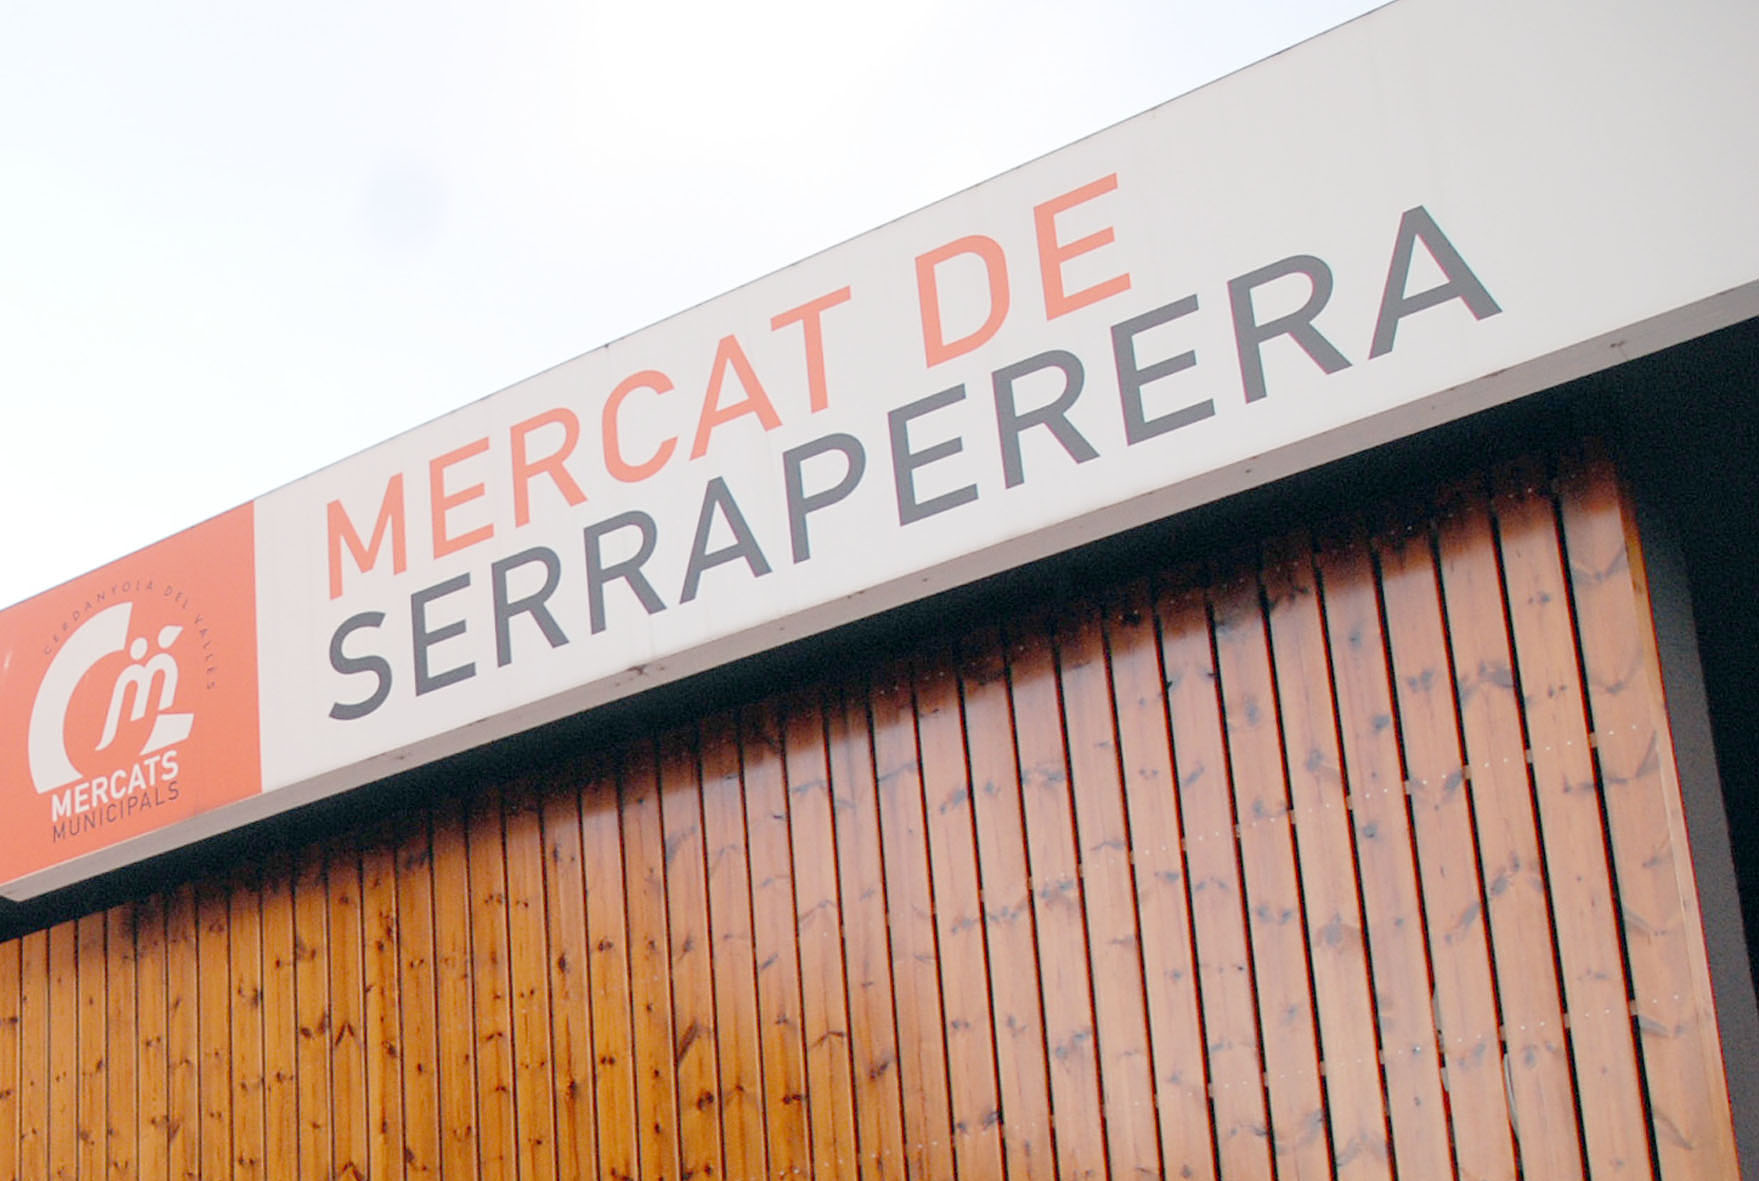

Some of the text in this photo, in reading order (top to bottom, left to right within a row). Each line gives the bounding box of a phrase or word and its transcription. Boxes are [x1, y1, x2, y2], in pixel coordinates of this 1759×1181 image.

[327, 172, 1133, 599] MERCAT DE
[327, 206, 1502, 721] SERRAPERERA
[43, 580, 153, 655] CERDANYOLA
[163, 585, 190, 610] DEL
[51, 750, 179, 822] MERCATS
[53, 781, 180, 843] MUNICIPALS
